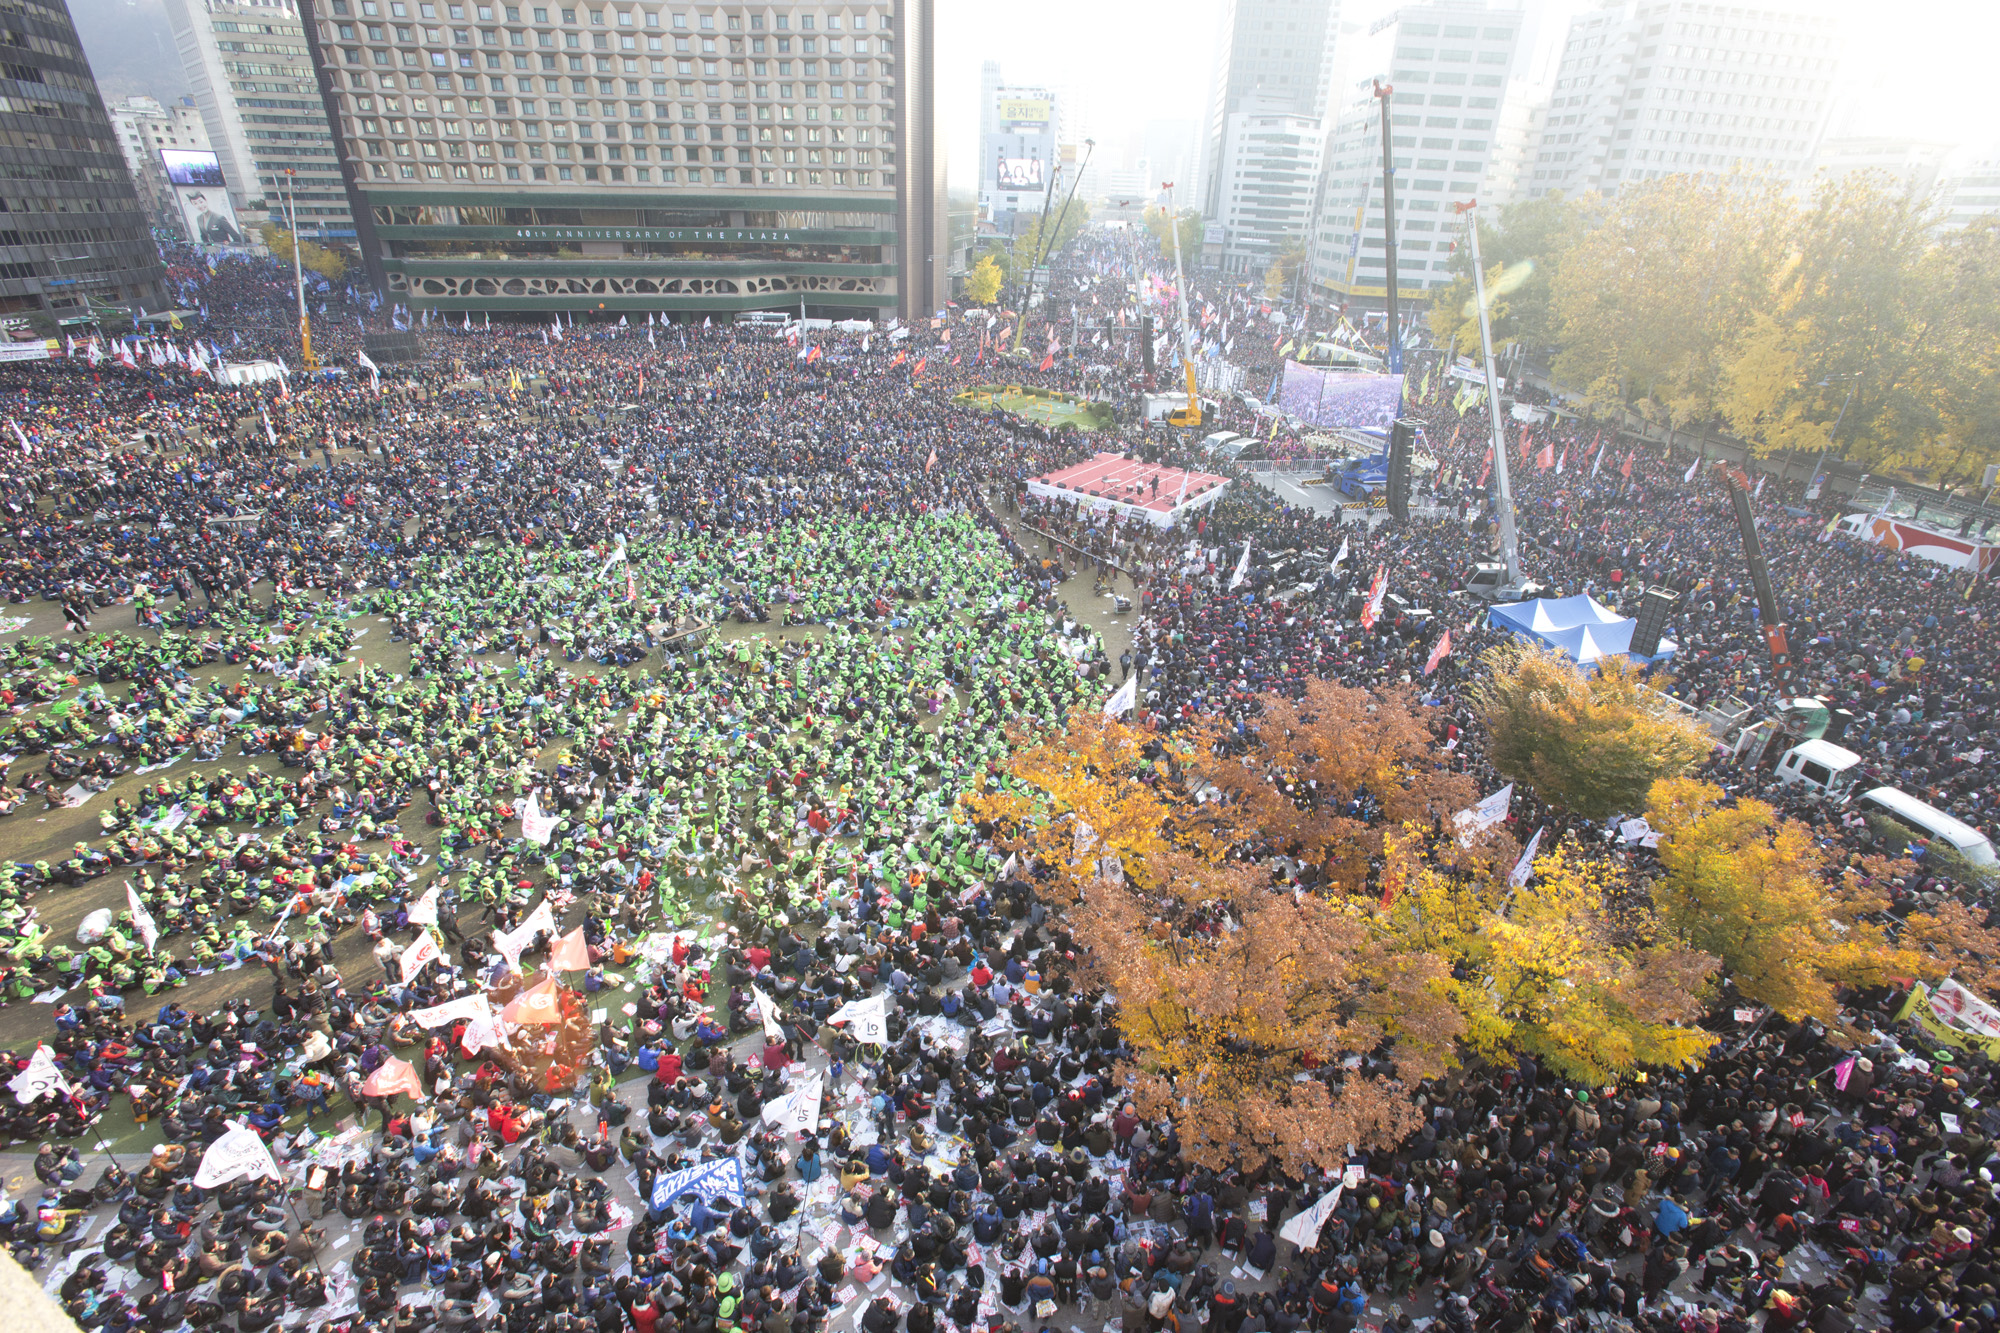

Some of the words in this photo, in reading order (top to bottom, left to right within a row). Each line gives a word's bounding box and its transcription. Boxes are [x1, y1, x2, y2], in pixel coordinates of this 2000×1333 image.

[516, 229, 547, 238] 40th
[556, 230, 660, 238] ANNIVERSARY
[695, 231, 725, 239] THE
[737, 232, 790, 240] PLAZA
